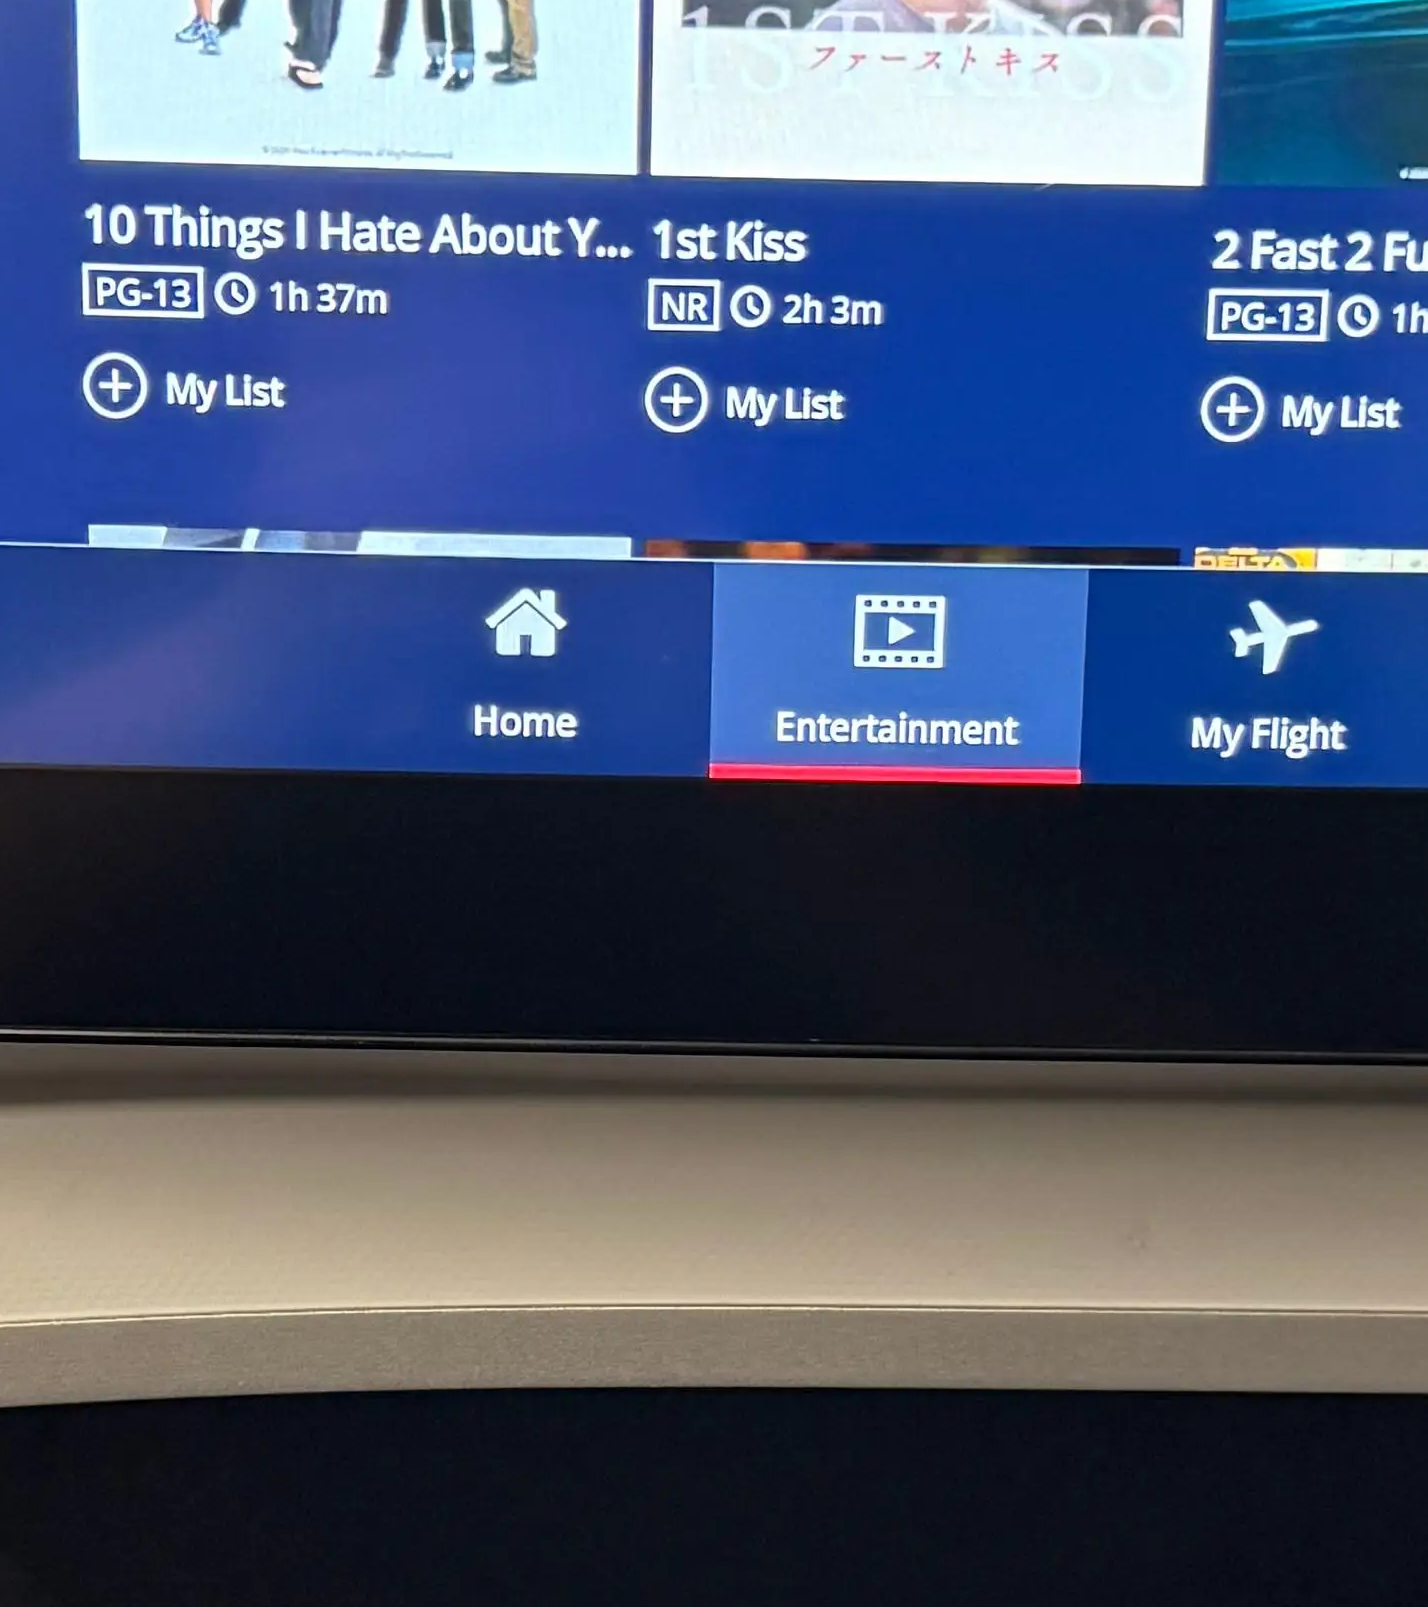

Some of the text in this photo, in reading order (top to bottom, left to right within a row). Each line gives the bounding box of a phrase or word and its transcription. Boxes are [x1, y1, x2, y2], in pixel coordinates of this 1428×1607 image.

[85, 204, 136, 244] 10
[144, 204, 285, 260] Things
[296, 210, 306, 249] I
[320, 210, 421, 252] Hate
[429, 213, 562, 256] About
[654, 220, 808, 261] 1st Kiss
[1212, 230, 1241, 269] 2
[1251, 230, 1339, 270] Fast
[1345, 232, 1373, 271] 2
[94, 277, 193, 309] PG-13
[270, 281, 387, 314] 1h 37m
[660, 292, 710, 322] NR
[783, 293, 883, 325] 2h 3m
[1220, 302, 1316, 332] PG-13
[167, 372, 285, 413] My List
[727, 386, 845, 426] My List
[1282, 395, 1401, 435] My List
[475, 705, 577, 741] Home
[777, 711, 1019, 745] Entertainment
[1192, 717, 1347, 759] My Flight
